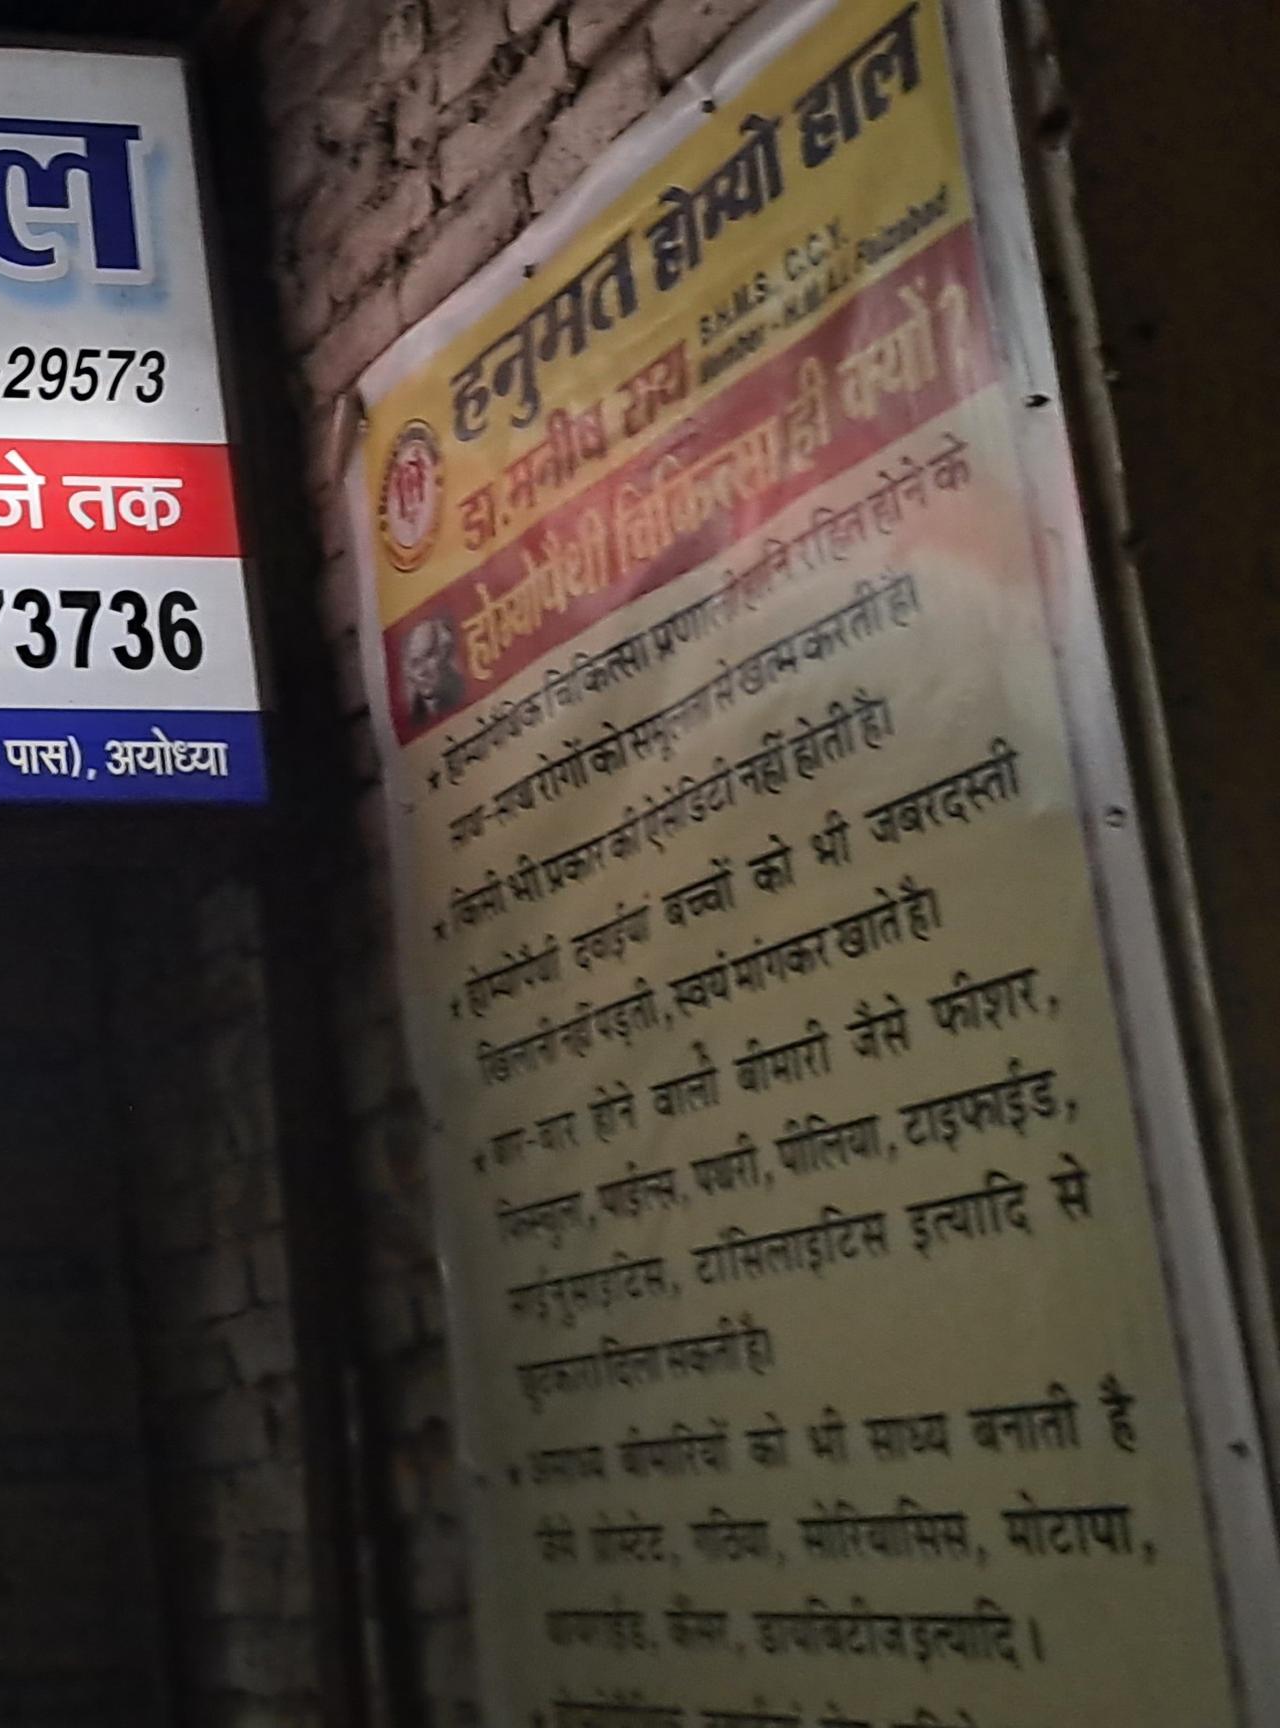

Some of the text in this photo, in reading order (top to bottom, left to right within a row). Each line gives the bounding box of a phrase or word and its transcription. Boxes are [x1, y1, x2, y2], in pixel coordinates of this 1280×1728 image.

[449, 1, 922, 443] हनुमत होम्यो हाल
[615, 340, 688, 437] राय
[62, 474, 183, 532] तक
[460, 514, 614, 681] होम्योपैथी
[616, 413, 783, 574] चिकित्सा
[780, 357, 829, 472] ही
[865, 455, 925, 533] होने
[925, 432, 971, 490] के
[5, 735, 97, 782] पास),
[104, 728, 229, 779] अयोध्या
[507, 853, 542, 901] भी
[734, 730, 787, 794] नहीं
[787, 700, 853, 779] होती
[536, 738, 588, 800] रोगों
[588, 720, 626, 774] को
[660, 857, 733, 925] बच्चों
[746, 833, 792, 892] को
[810, 809, 849, 865] भी
[863, 736, 1019, 842] जबरदस्ती
[667, 950, 728, 1015] स्वयं
[729, 926, 829, 986] मांगकर
[830, 886, 900, 958] खाते
[587, 1080, 634, 1143] होने
[733, 1018, 829, 1090] बीमारी
[845, 993, 908, 1056] जैसे
[904, 1169, 1031, 1254] इत्यादि
[1048, 1152, 1090, 1219] से
[744, 1411, 787, 1466] को
[808, 1405, 846, 1457] भी
[967, 1381, 1078, 1450] बनाती
[1099, 1374, 1135, 1453] है
